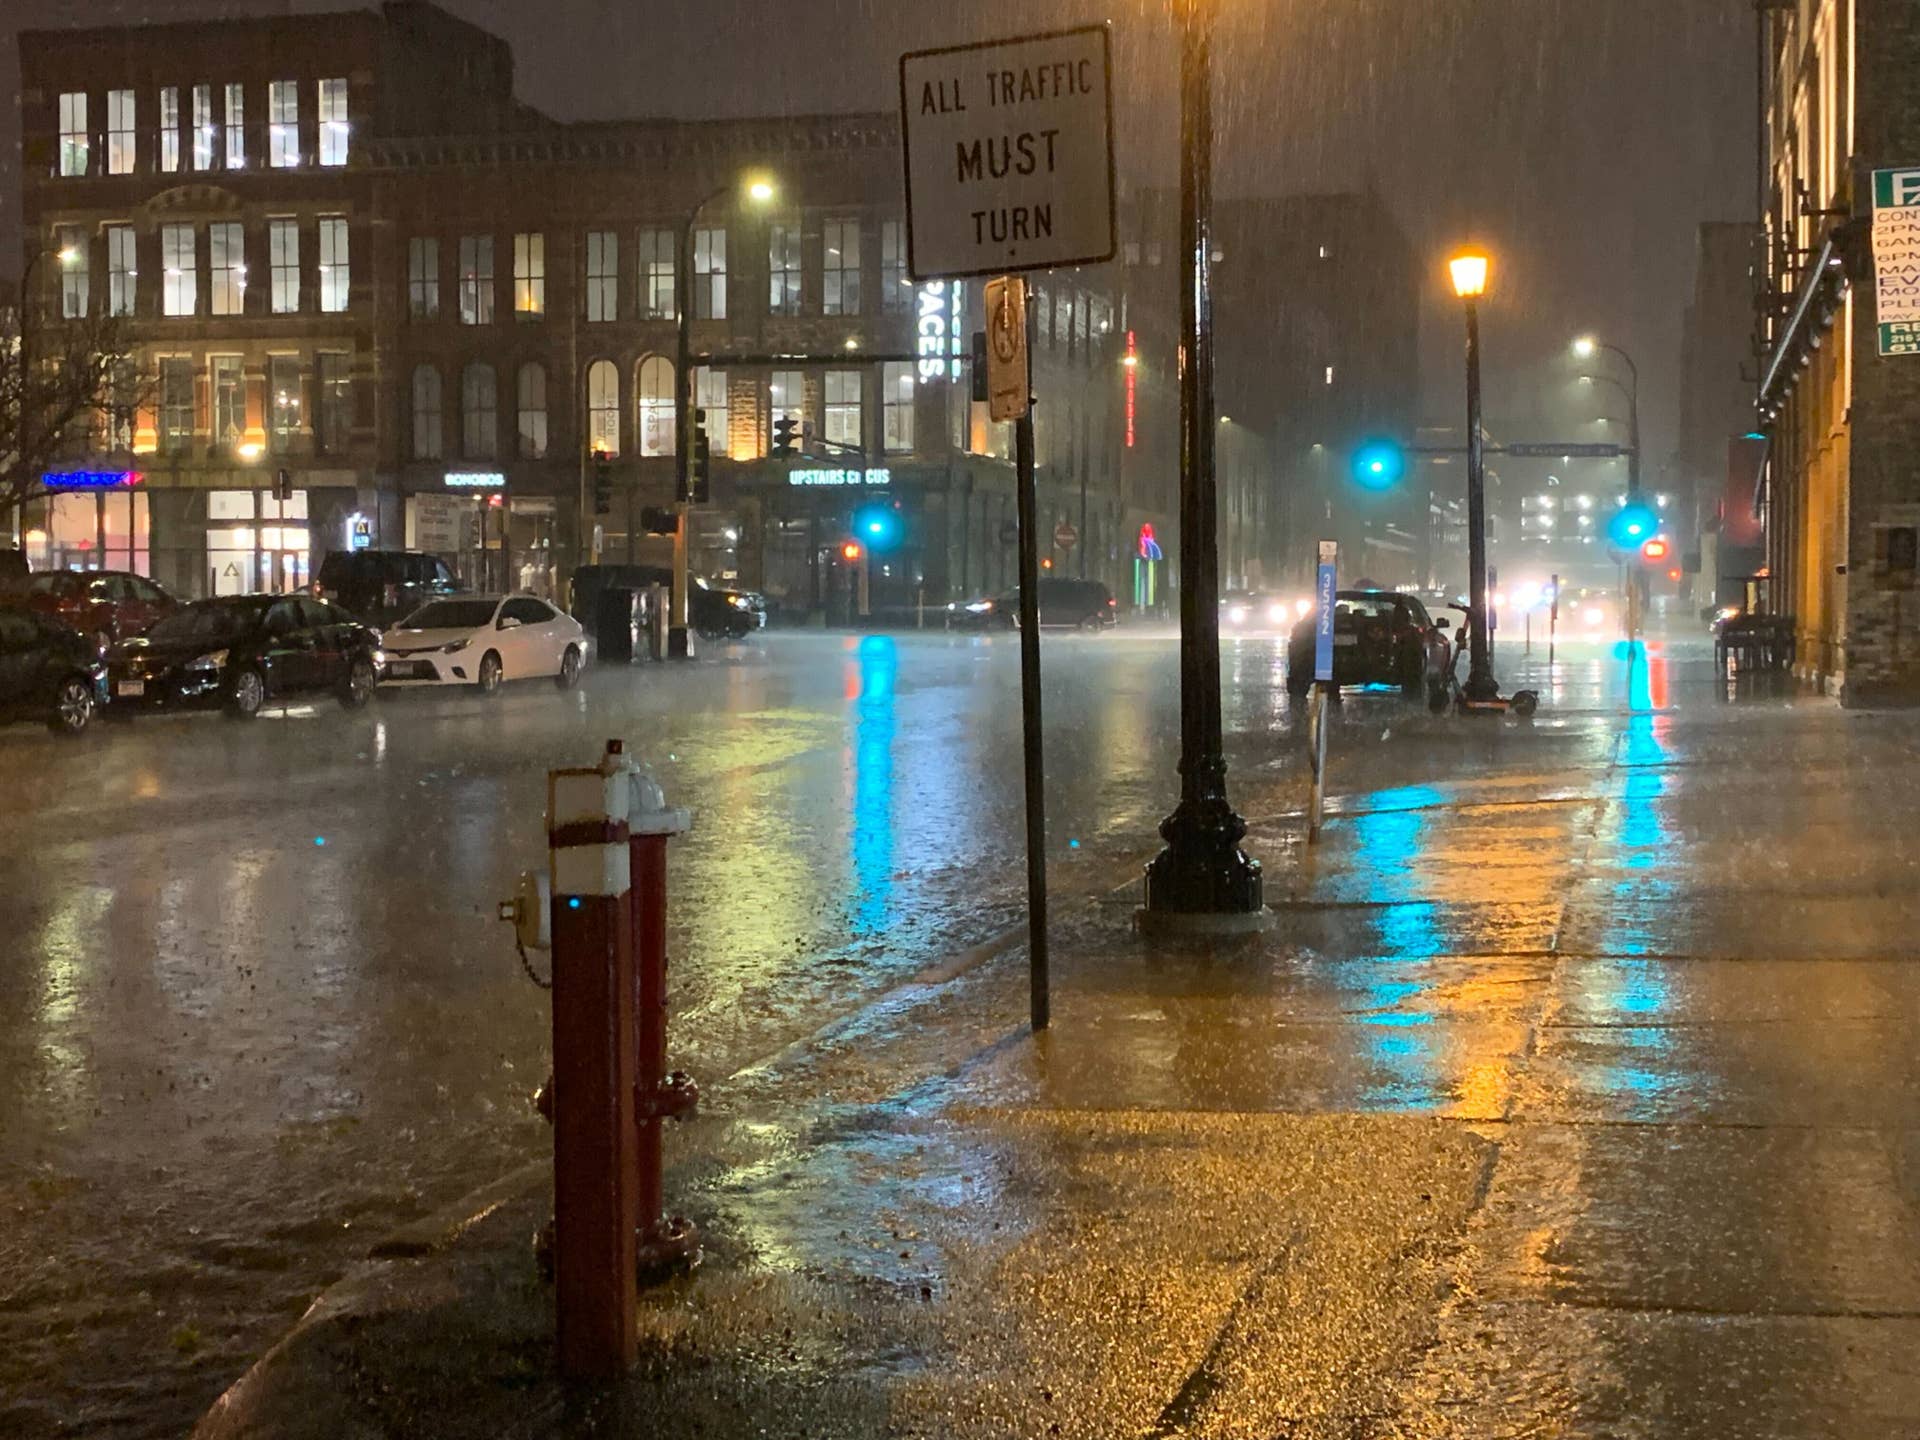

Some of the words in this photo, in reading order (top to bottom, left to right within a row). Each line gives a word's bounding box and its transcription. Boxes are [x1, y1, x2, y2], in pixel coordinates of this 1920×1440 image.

[922, 78, 966, 115] ALL
[987, 58, 1093, 107] TRAFFIC
[957, 129, 1059, 183] MUST
[971, 203, 1053, 245] TURN
[1878, 209, 1920, 223] CON
[789, 469, 845, 485] UPSTAIRS
[1321, 572, 1331, 635] 3522
